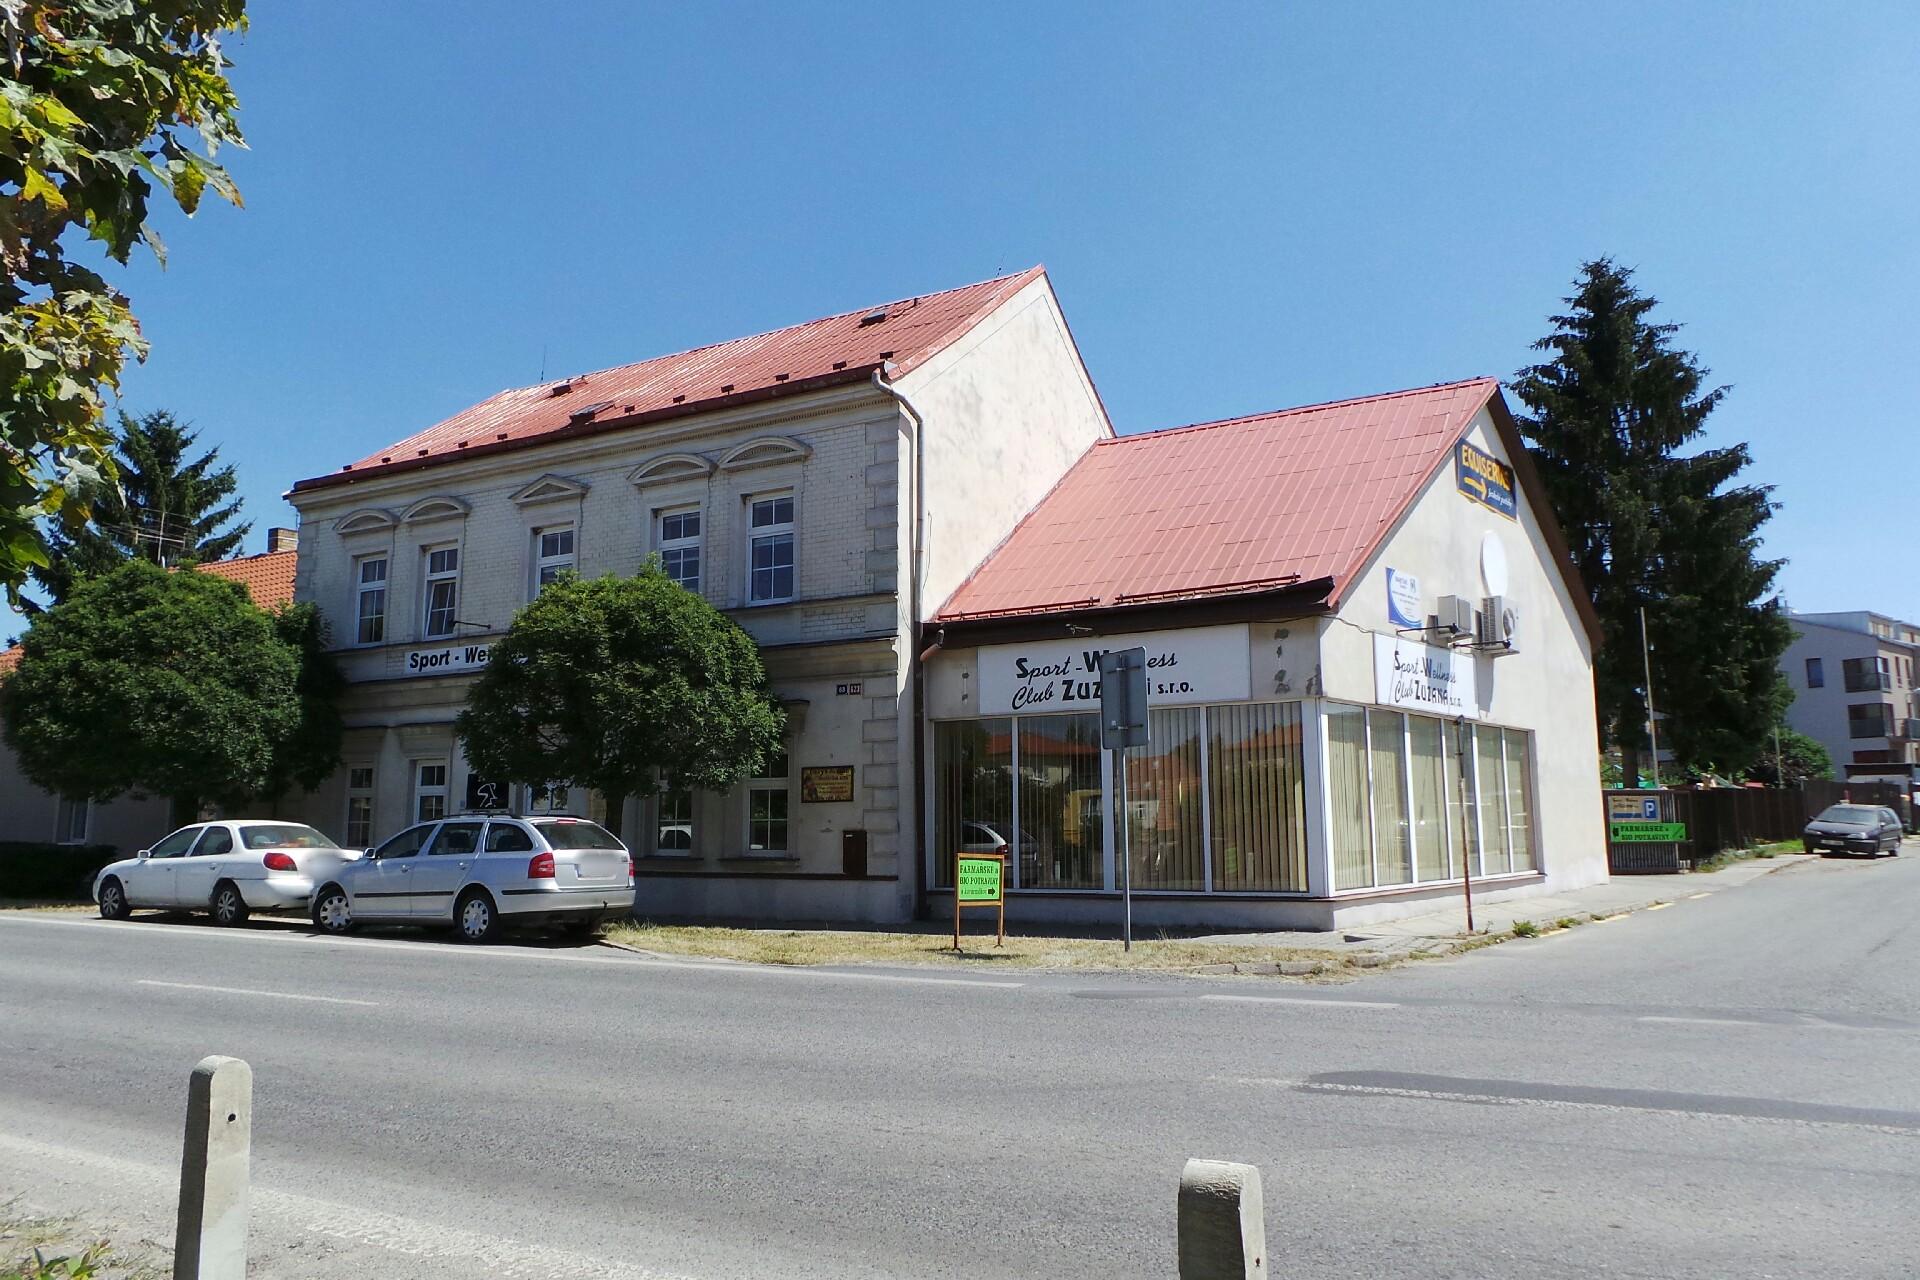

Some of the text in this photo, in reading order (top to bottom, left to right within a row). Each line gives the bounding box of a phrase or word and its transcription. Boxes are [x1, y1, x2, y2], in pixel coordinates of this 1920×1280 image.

[410, 650, 450, 671] Sport
[1016, 656, 1070, 685] Sport
[1394, 651, 1419, 680] Sport
[1012, 681, 1054, 710] Club
[1158, 682, 1194, 694] s.r.o.
[1395, 679, 1413, 703] Club
[1415, 680, 1448, 705] ZUZANA
[1646, 803, 1655, 816] P
[960, 876, 969, 885] BIO
